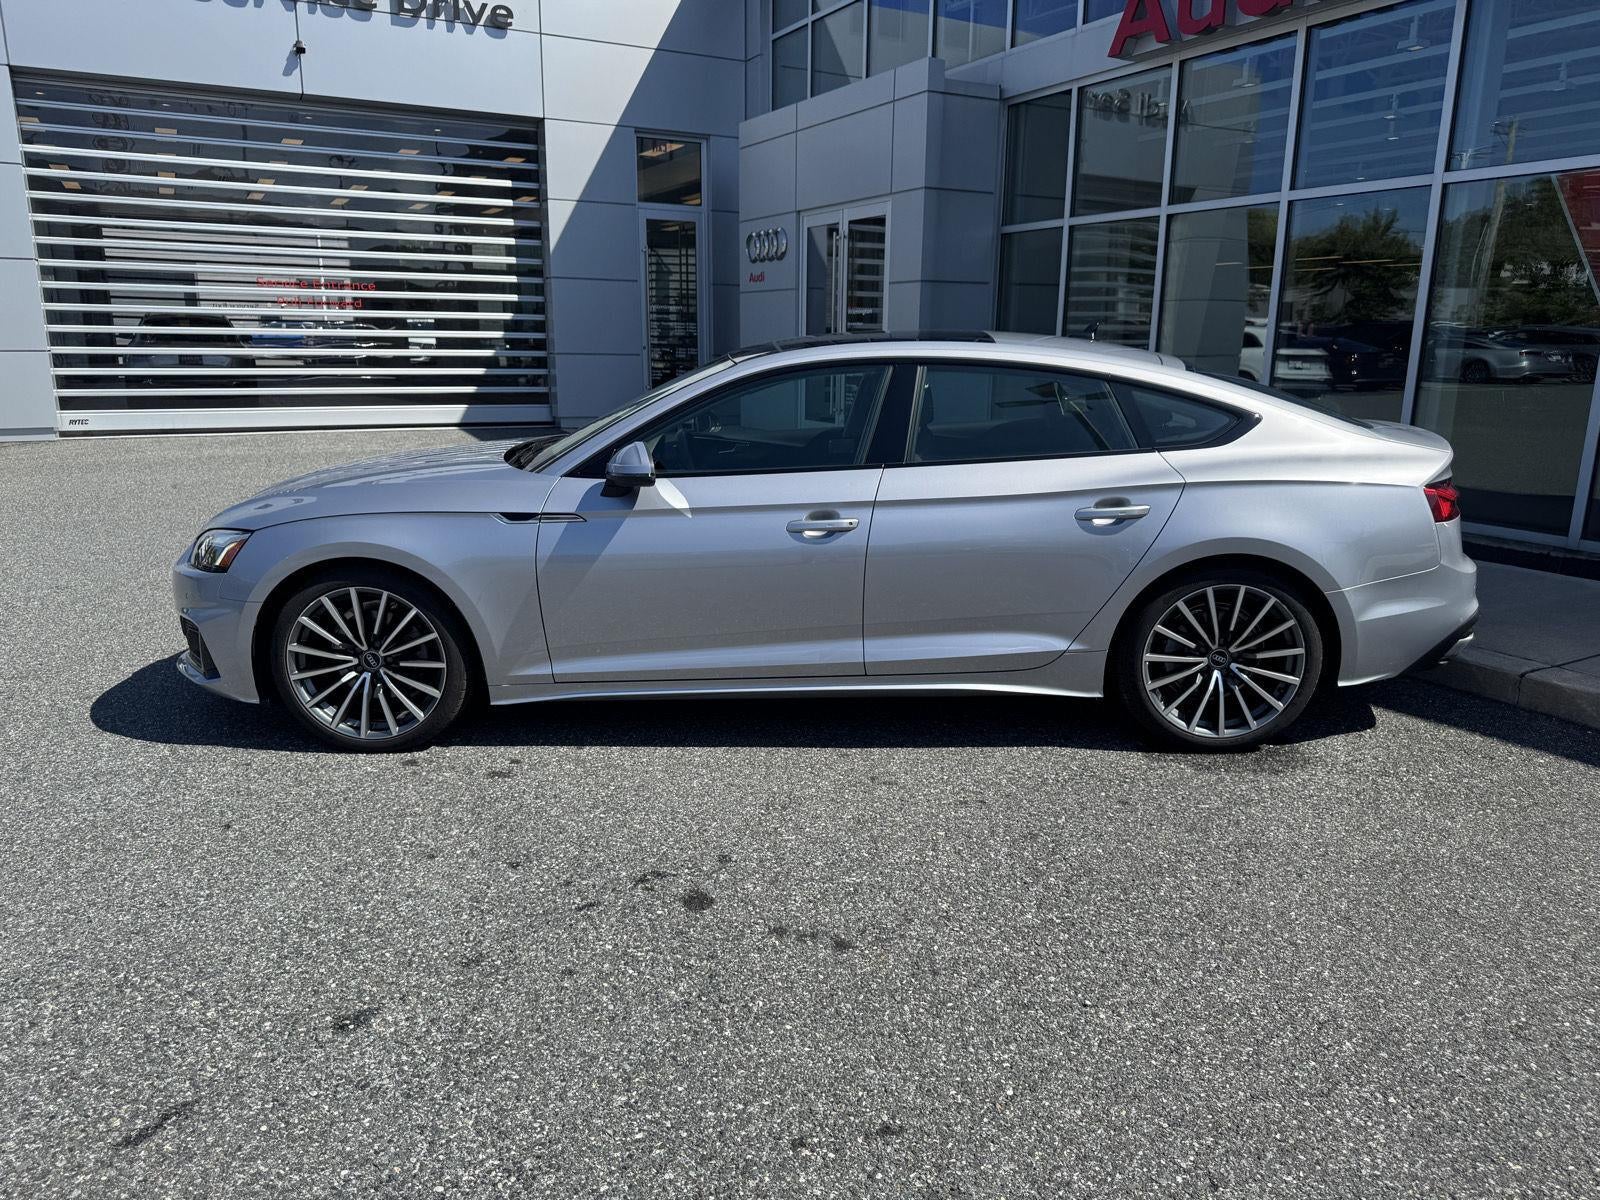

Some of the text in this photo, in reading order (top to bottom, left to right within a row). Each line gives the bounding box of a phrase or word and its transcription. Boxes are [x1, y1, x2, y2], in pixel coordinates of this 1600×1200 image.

[749, 271, 765, 283] Audi
[312, 279, 376, 291] Entrance
[69, 418, 89, 426] RYTEC
